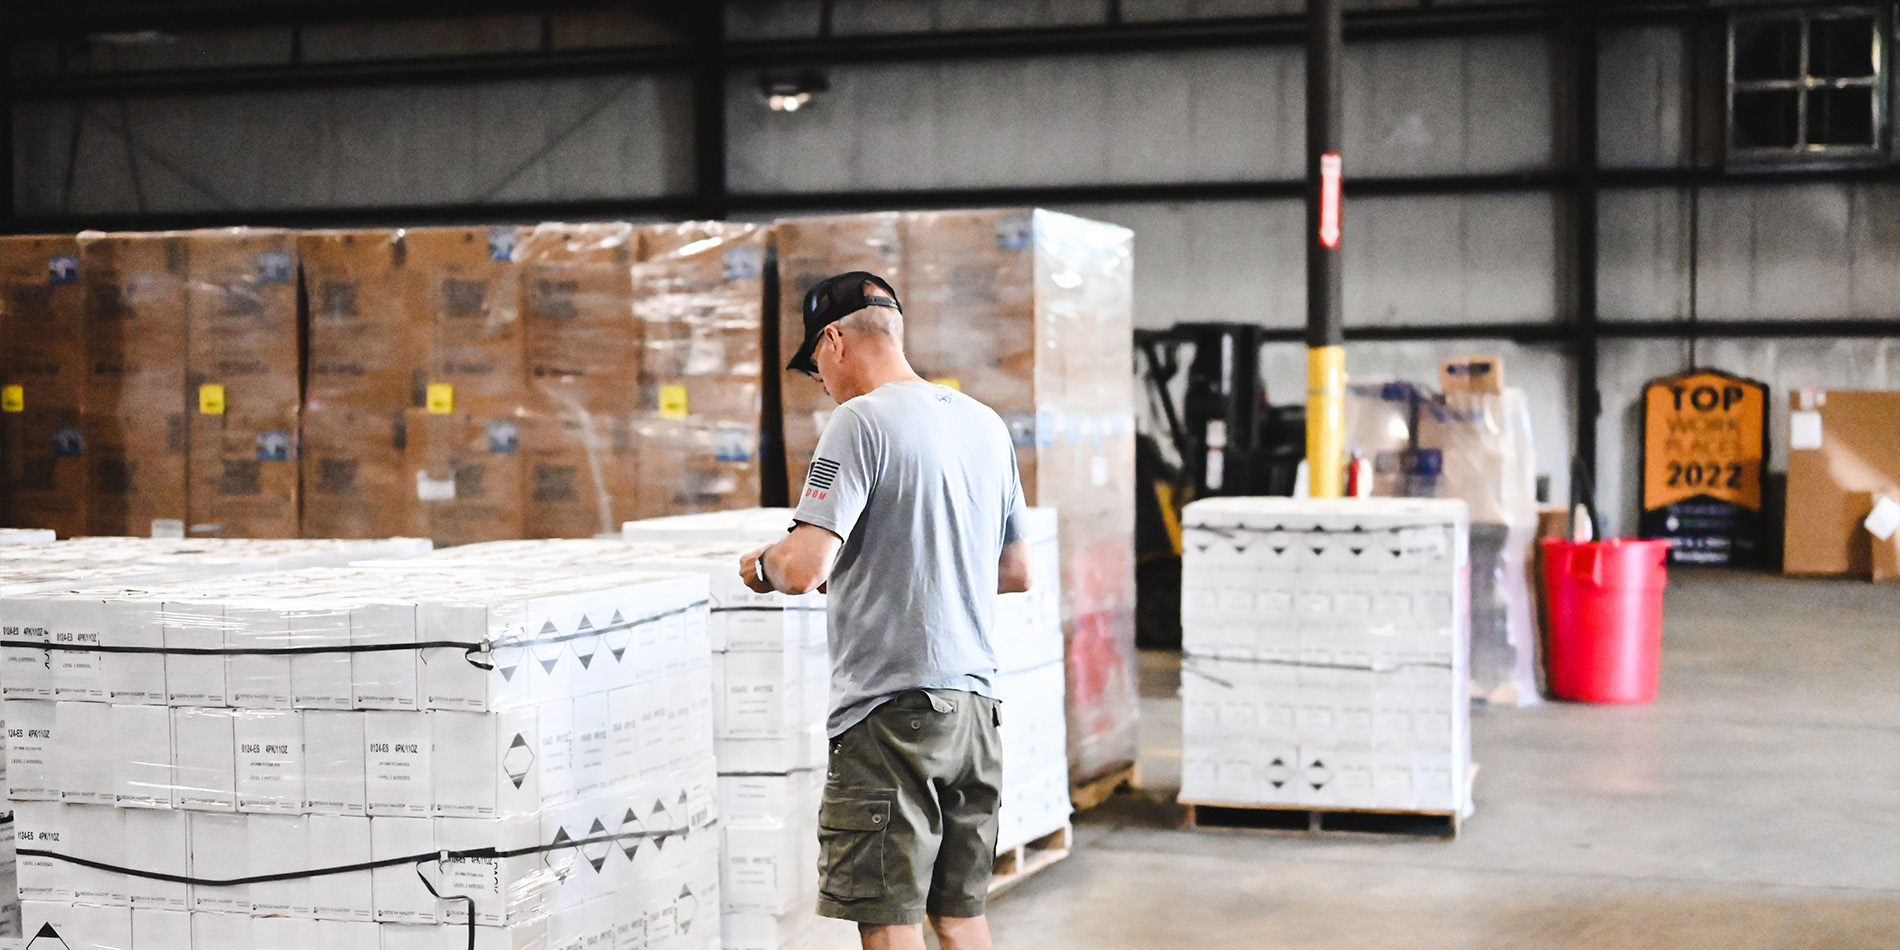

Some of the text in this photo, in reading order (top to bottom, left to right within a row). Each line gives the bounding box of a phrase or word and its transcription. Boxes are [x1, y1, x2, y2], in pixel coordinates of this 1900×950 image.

[1669, 385, 1743, 411] TOP
[1667, 460, 1742, 487] 2022
[806, 487, 828, 500] DOM
[242, 744, 260, 753] 0124-ES
[370, 744, 389, 752] 0124-ES
